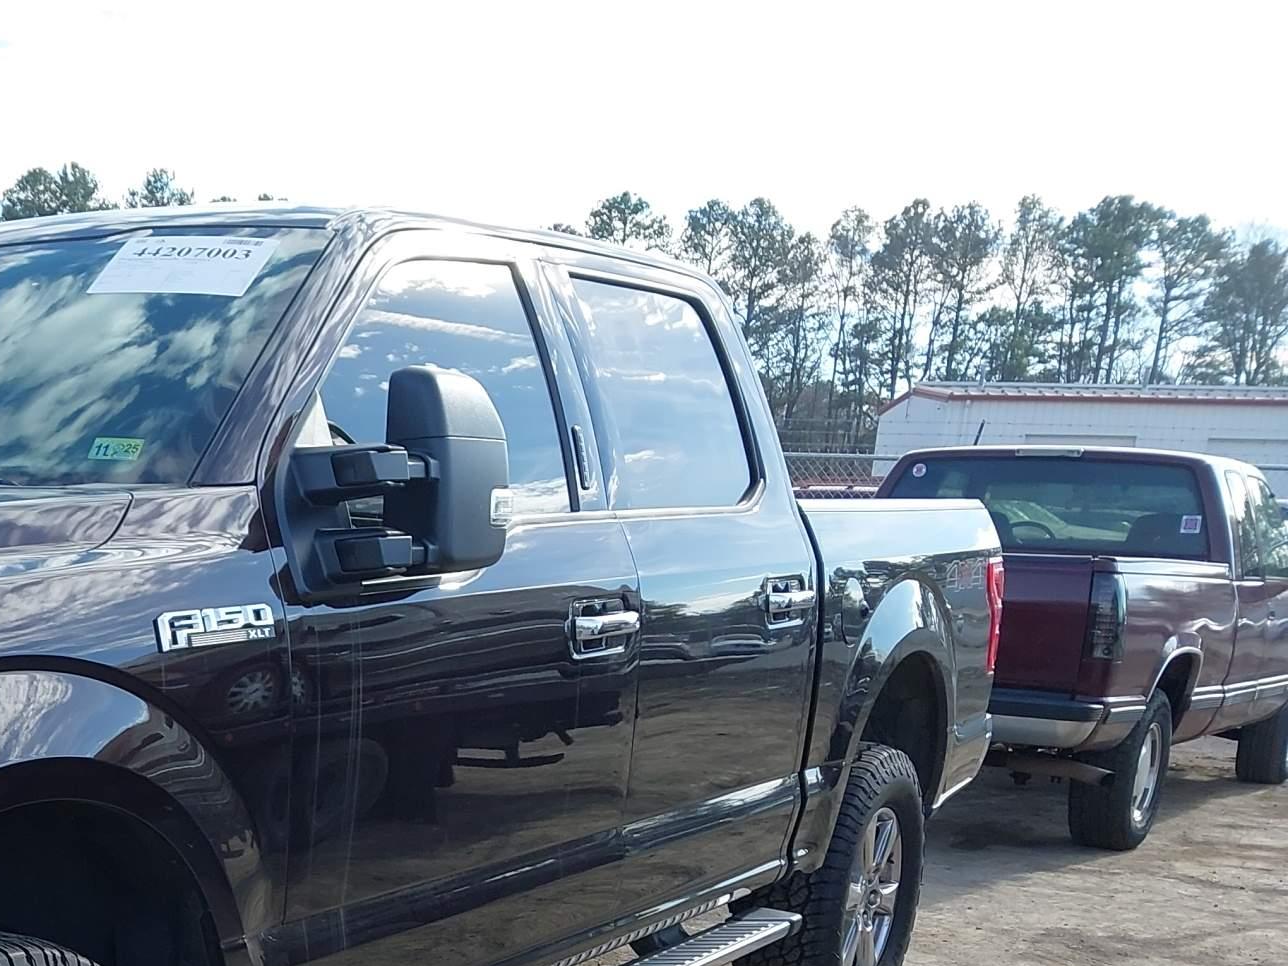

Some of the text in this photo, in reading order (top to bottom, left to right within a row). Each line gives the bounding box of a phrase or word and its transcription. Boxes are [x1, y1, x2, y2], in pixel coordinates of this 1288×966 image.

[133, 246, 252, 260] 44207003
[95, 442, 110, 457] 11
[248, 627, 272, 639] XLT
